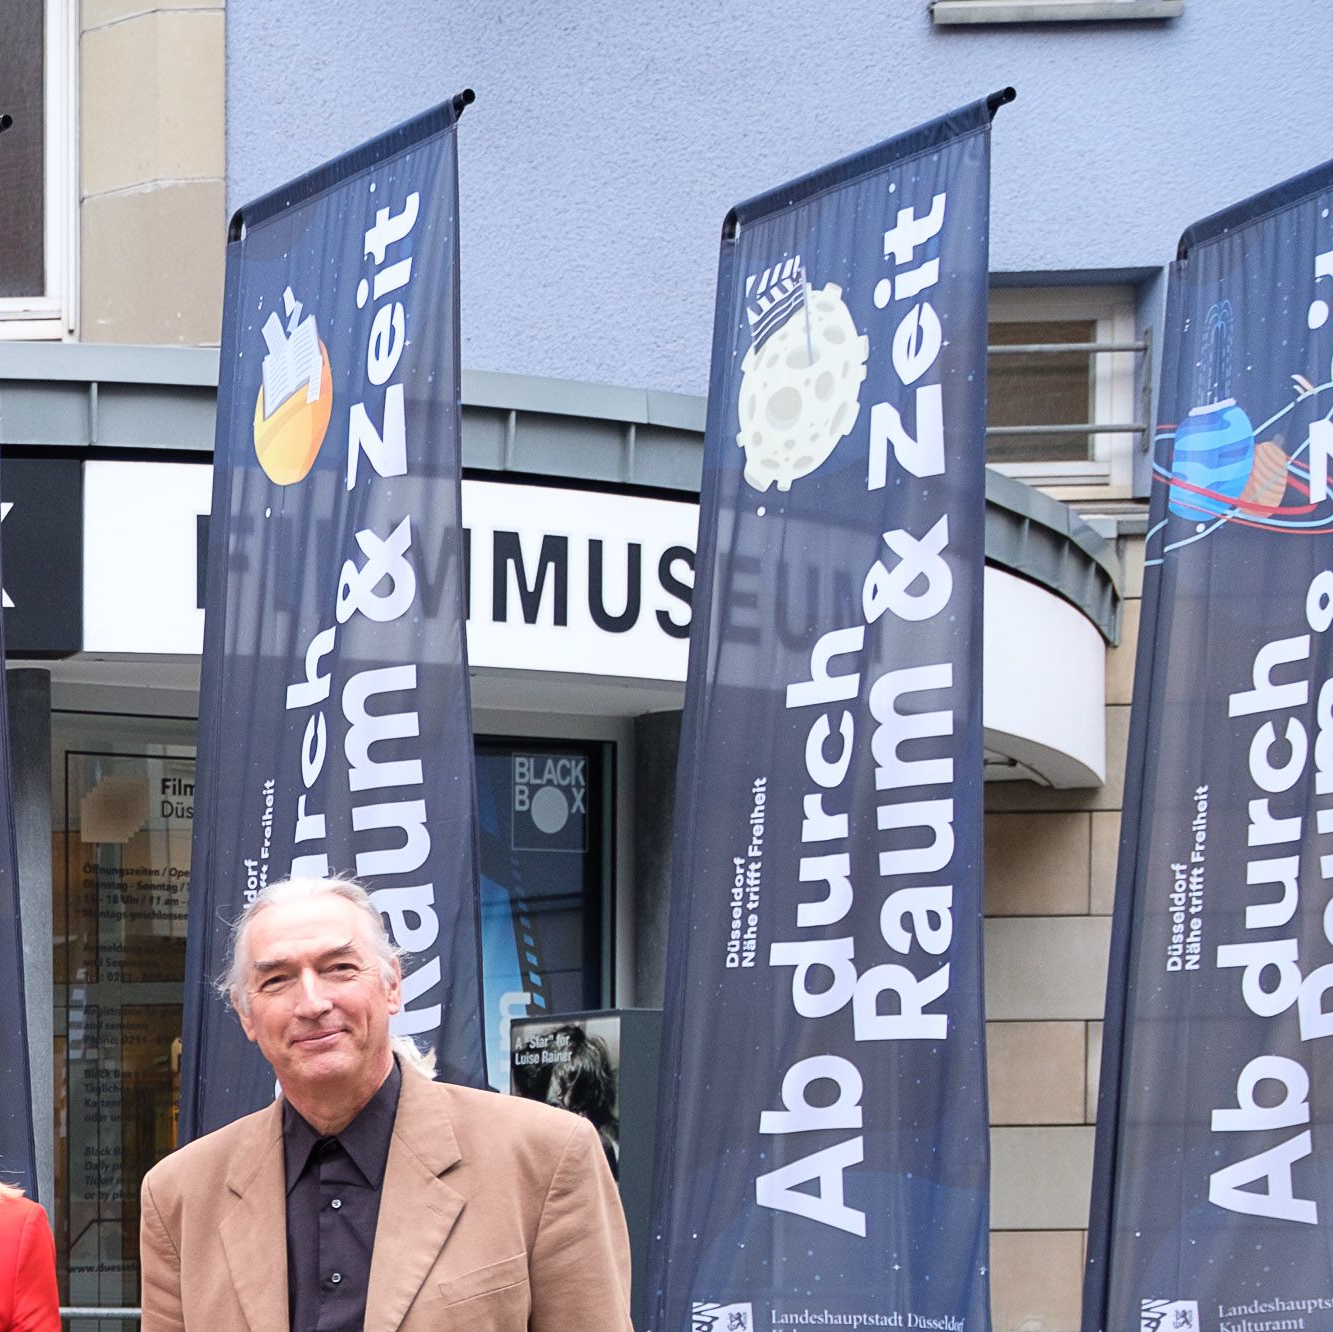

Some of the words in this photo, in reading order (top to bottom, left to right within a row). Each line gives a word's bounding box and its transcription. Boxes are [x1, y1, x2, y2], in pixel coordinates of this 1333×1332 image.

[347, 192, 419, 490] Zeit
[868, 193, 946, 490] Zeit
[336, 514, 416, 623] &
[863, 514, 952, 623] &
[514, 757, 586, 786] BLACK
[748, 776, 767, 857] Freiheit
[261, 779, 275, 859] Freiheit
[770, 626, 864, 1018] durch
[853, 663, 954, 1041] Raum
[1191, 784, 1209, 863] Freiheit
[1217, 635, 1311, 1016] durch
[726, 857, 745, 968] Düsseldorf
[745, 862, 762, 910] trifft
[1166, 863, 1188, 971] Düsseldorf
[1189, 867, 1204, 915] trifft
[741, 913, 758, 968] Nähe
[1185, 917, 1202, 971] Nähe
[515, 1037, 523, 1050] A
[556, 1032, 571, 1048] for
[515, 1051, 540, 1066] Luise
[541, 1048, 572, 1064] Rainer
[756, 1056, 865, 1237] Ab
[1209, 1056, 1313, 1224] Ab
[771, 1309, 903, 1329] Landeshauptstadt
[907, 1313, 965, 1332] Düsseldorf
